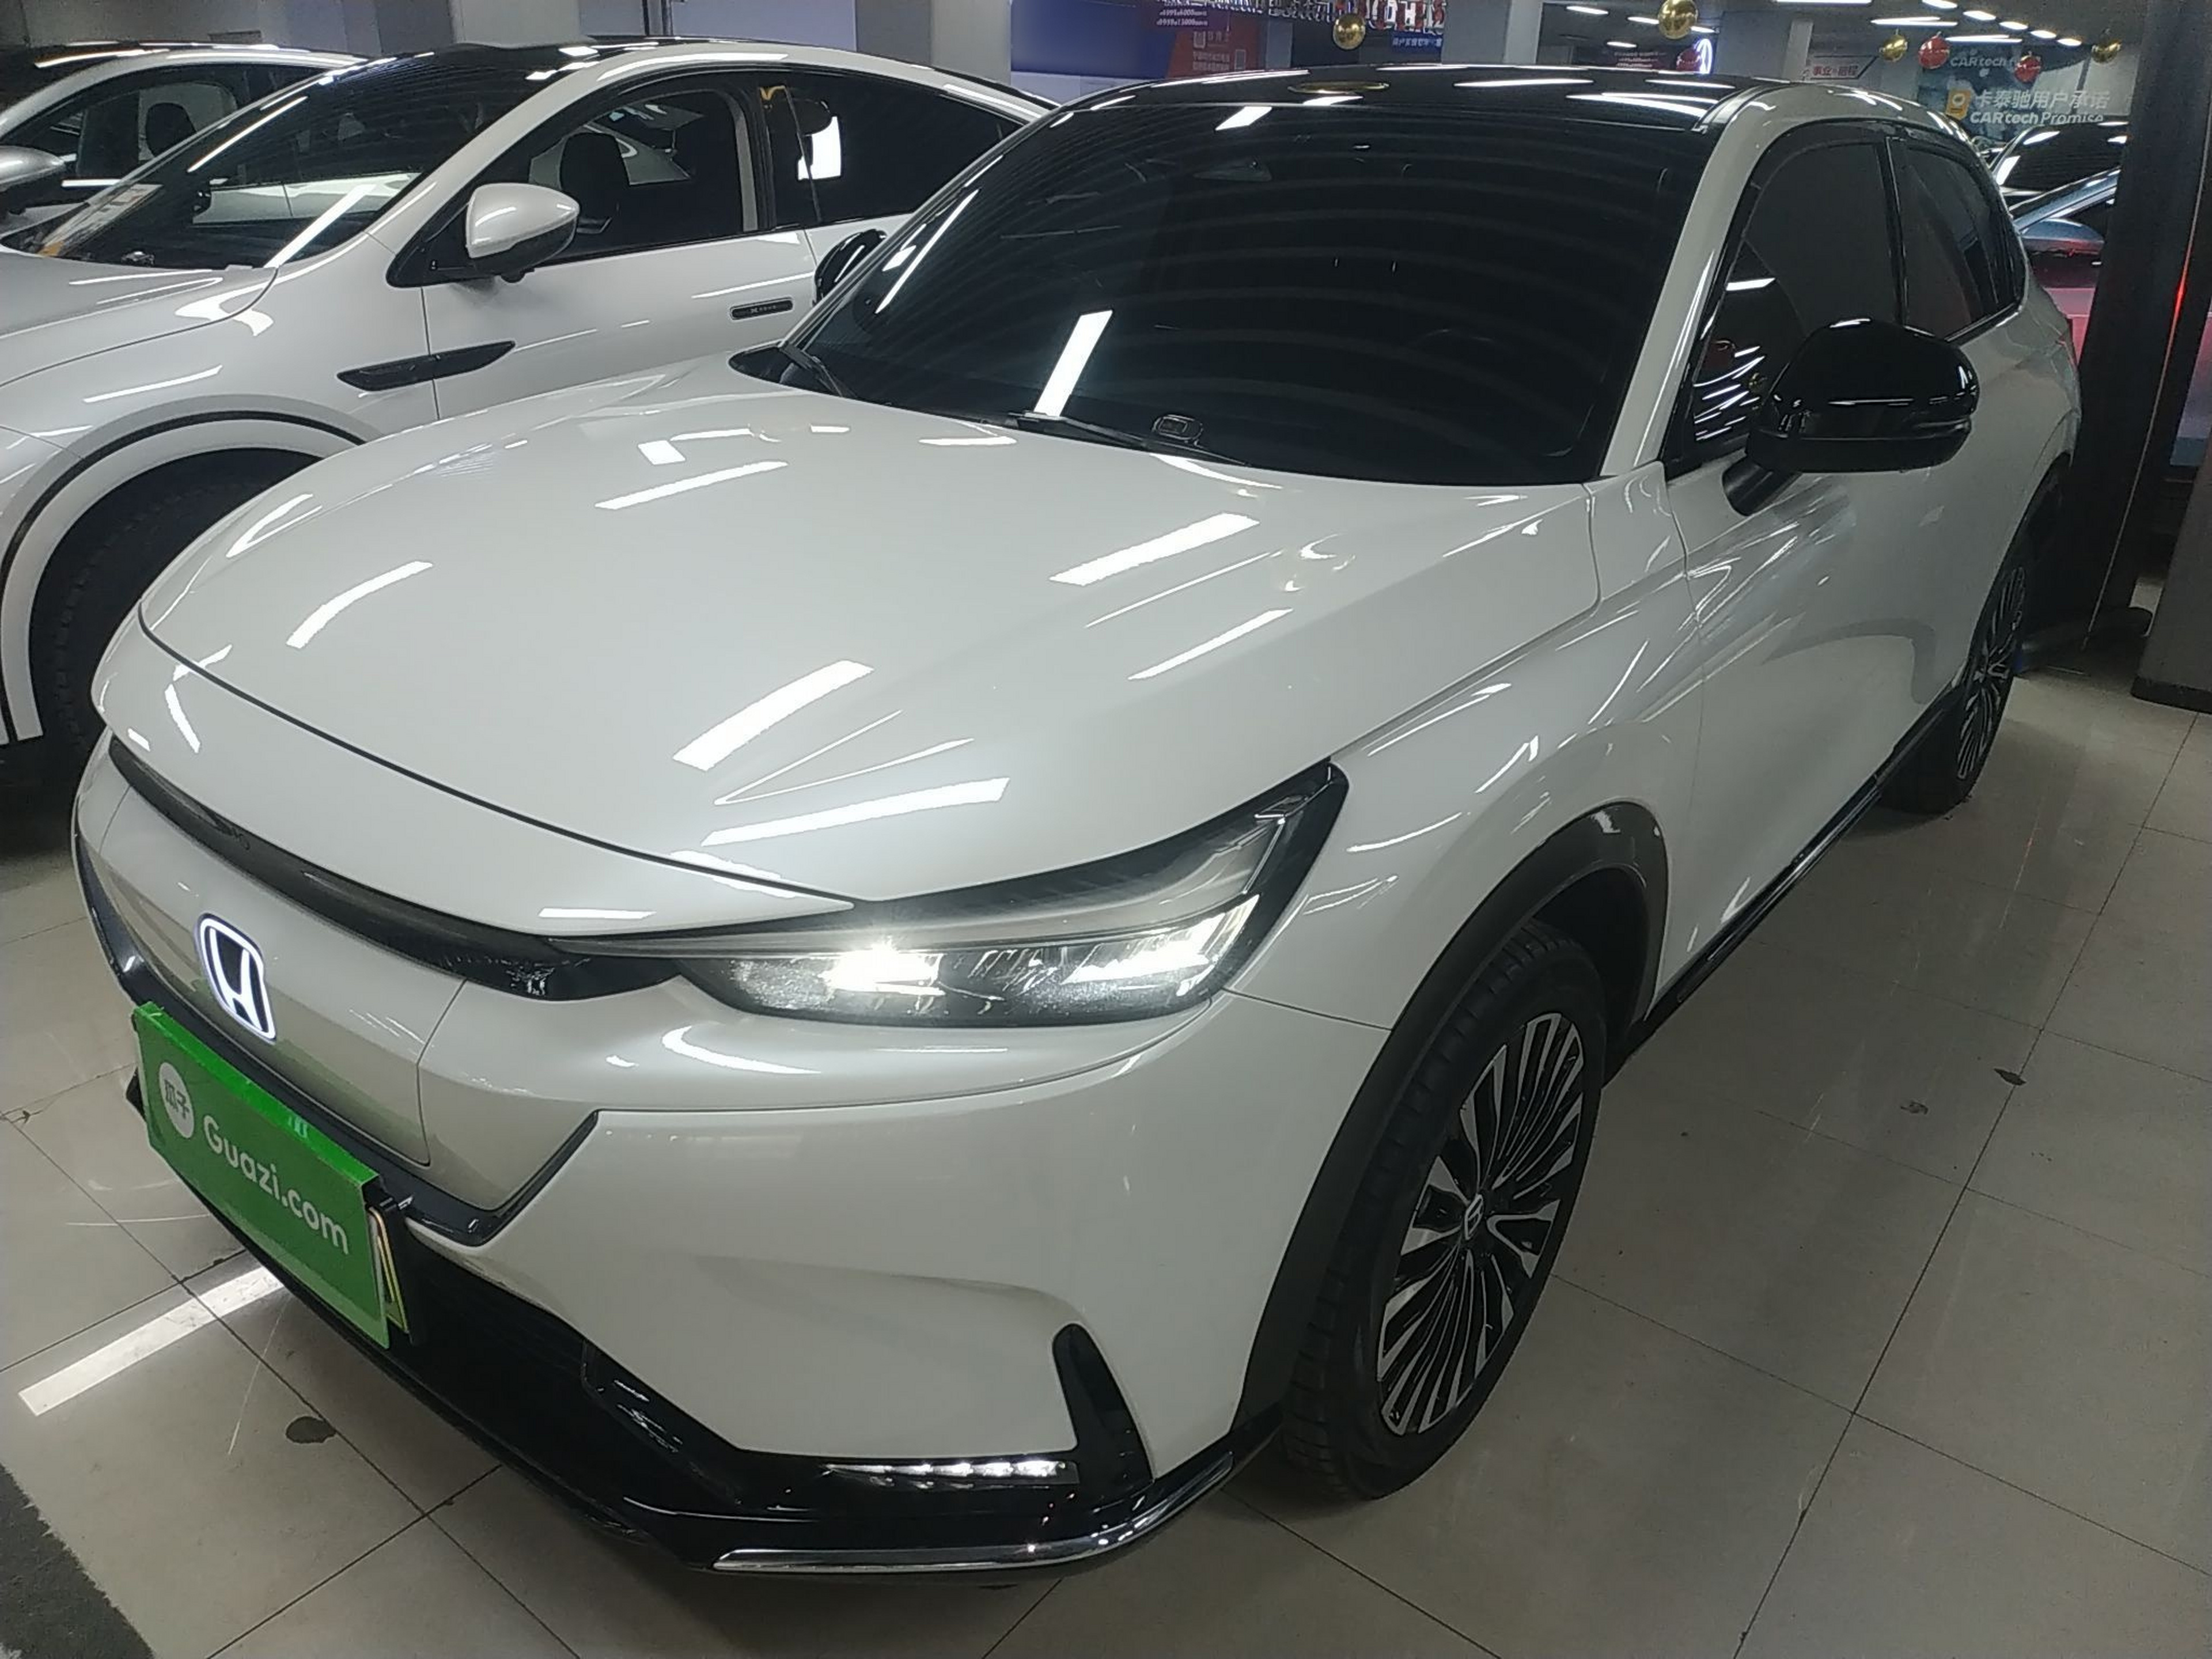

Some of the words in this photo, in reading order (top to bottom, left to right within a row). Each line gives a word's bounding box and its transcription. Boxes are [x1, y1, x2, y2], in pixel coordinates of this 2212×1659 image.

[1975, 89, 2111, 110] 卡泰驰用户承诺
[1970, 111, 2039, 124] CARtech
[2040, 113, 2103, 124] Promise
[203, 1115, 349, 1255] Guazi.com
